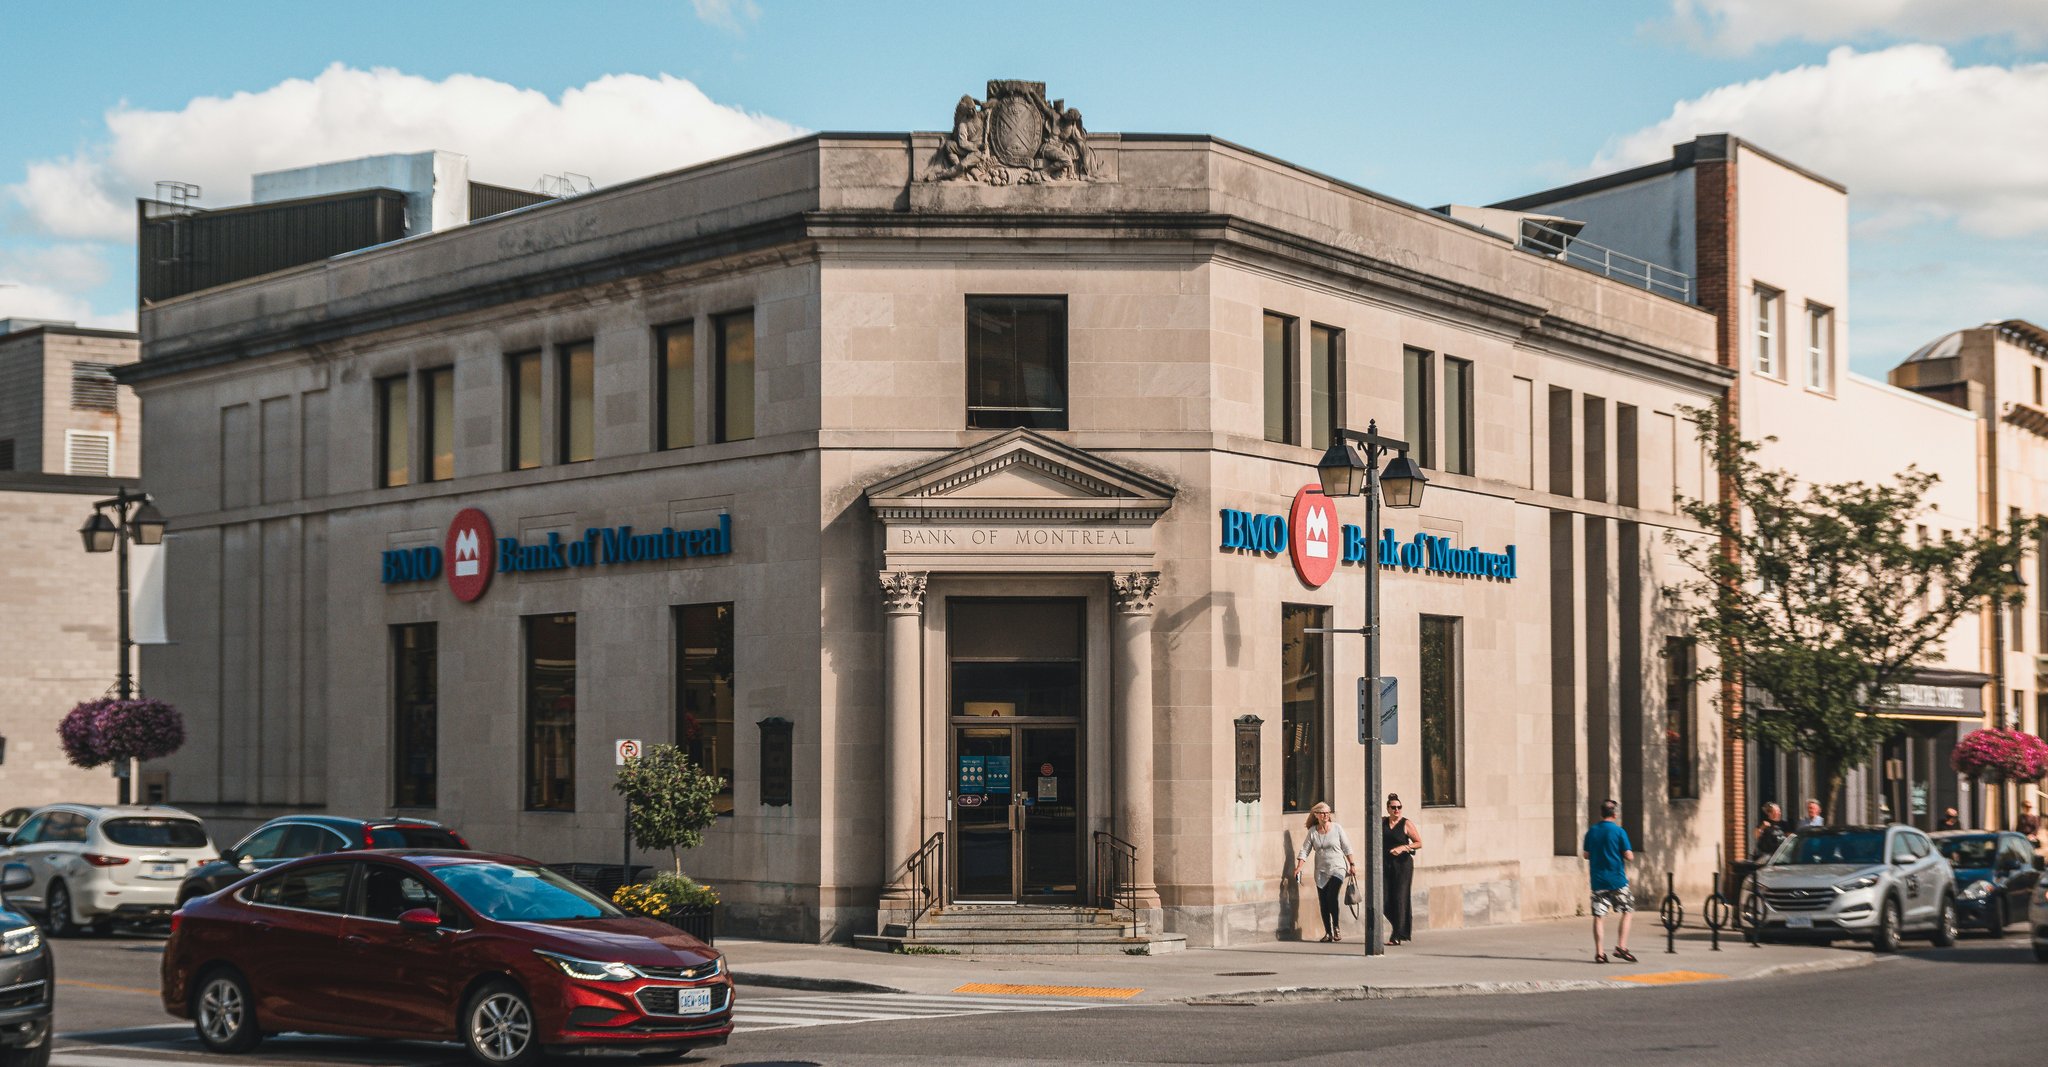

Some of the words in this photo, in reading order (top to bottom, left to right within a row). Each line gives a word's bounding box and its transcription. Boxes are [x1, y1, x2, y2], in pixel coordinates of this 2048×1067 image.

[382, 546, 442, 584] BMO
[497, 532, 566, 573] Bank
[567, 527, 600, 567] of
[600, 513, 732, 564] Montreal
[902, 529, 956, 545] BANK
[971, 530, 998, 545] OF
[1015, 530, 1135, 545] MONTREAL
[1221, 508, 1288, 553] BMO
[1401, 532, 1427, 569] of
[1427, 535, 1517, 578] Montreal
